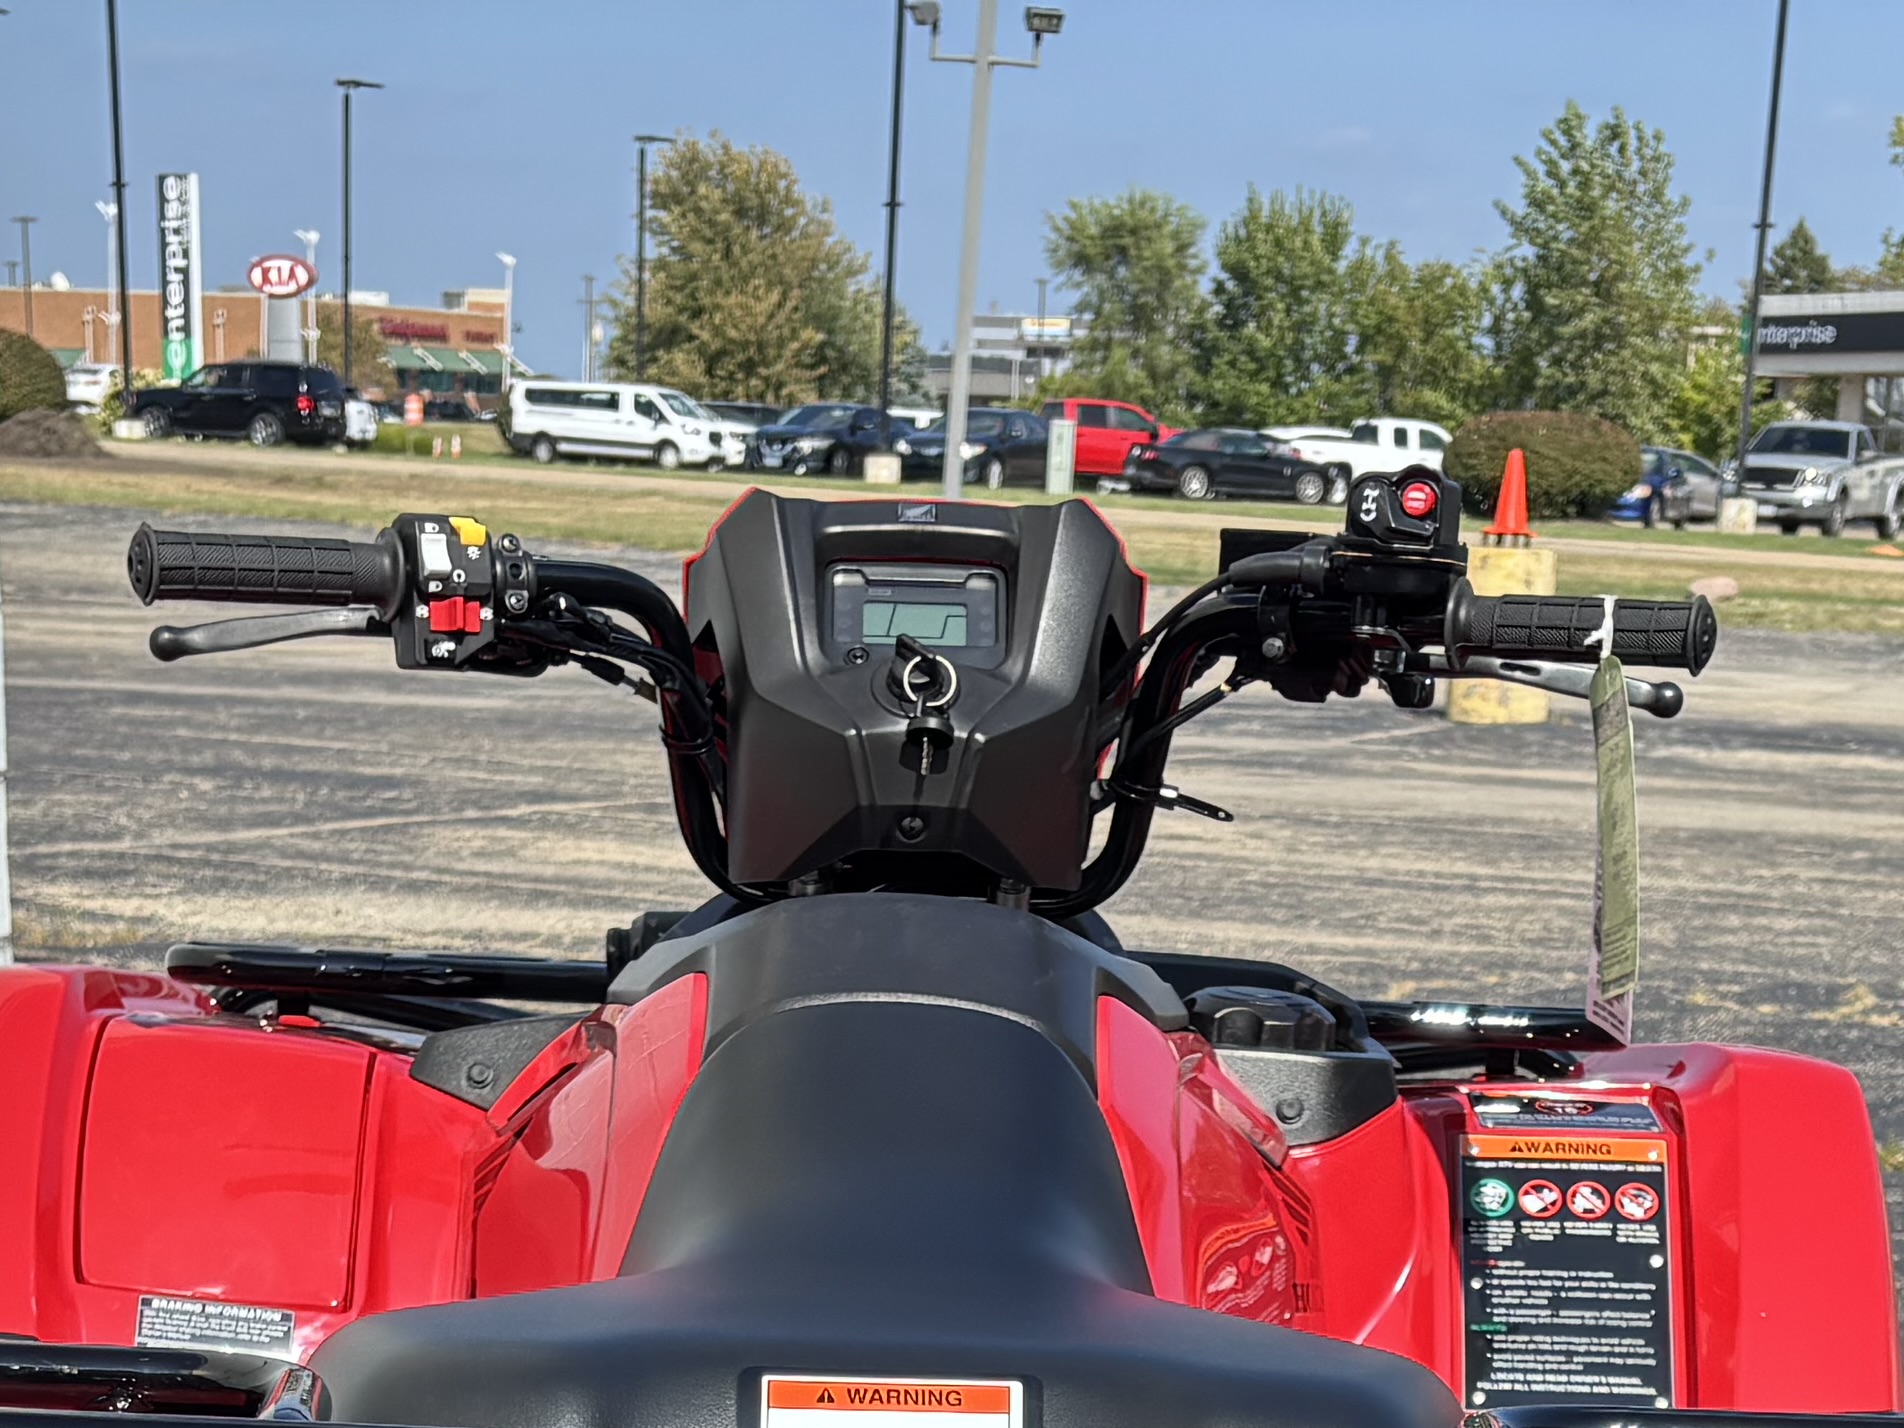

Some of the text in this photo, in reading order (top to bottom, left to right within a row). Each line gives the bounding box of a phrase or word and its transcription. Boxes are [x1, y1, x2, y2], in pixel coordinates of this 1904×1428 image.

[161, 175, 187, 374] enterprise
[262, 263, 297, 286] KIA
[1741, 320, 1837, 349] nterprise
[1524, 1141, 1612, 1156] WARNING
[151, 1298, 283, 1322] BRAKING INFORMATION
[847, 1388, 962, 1407] WARNING
